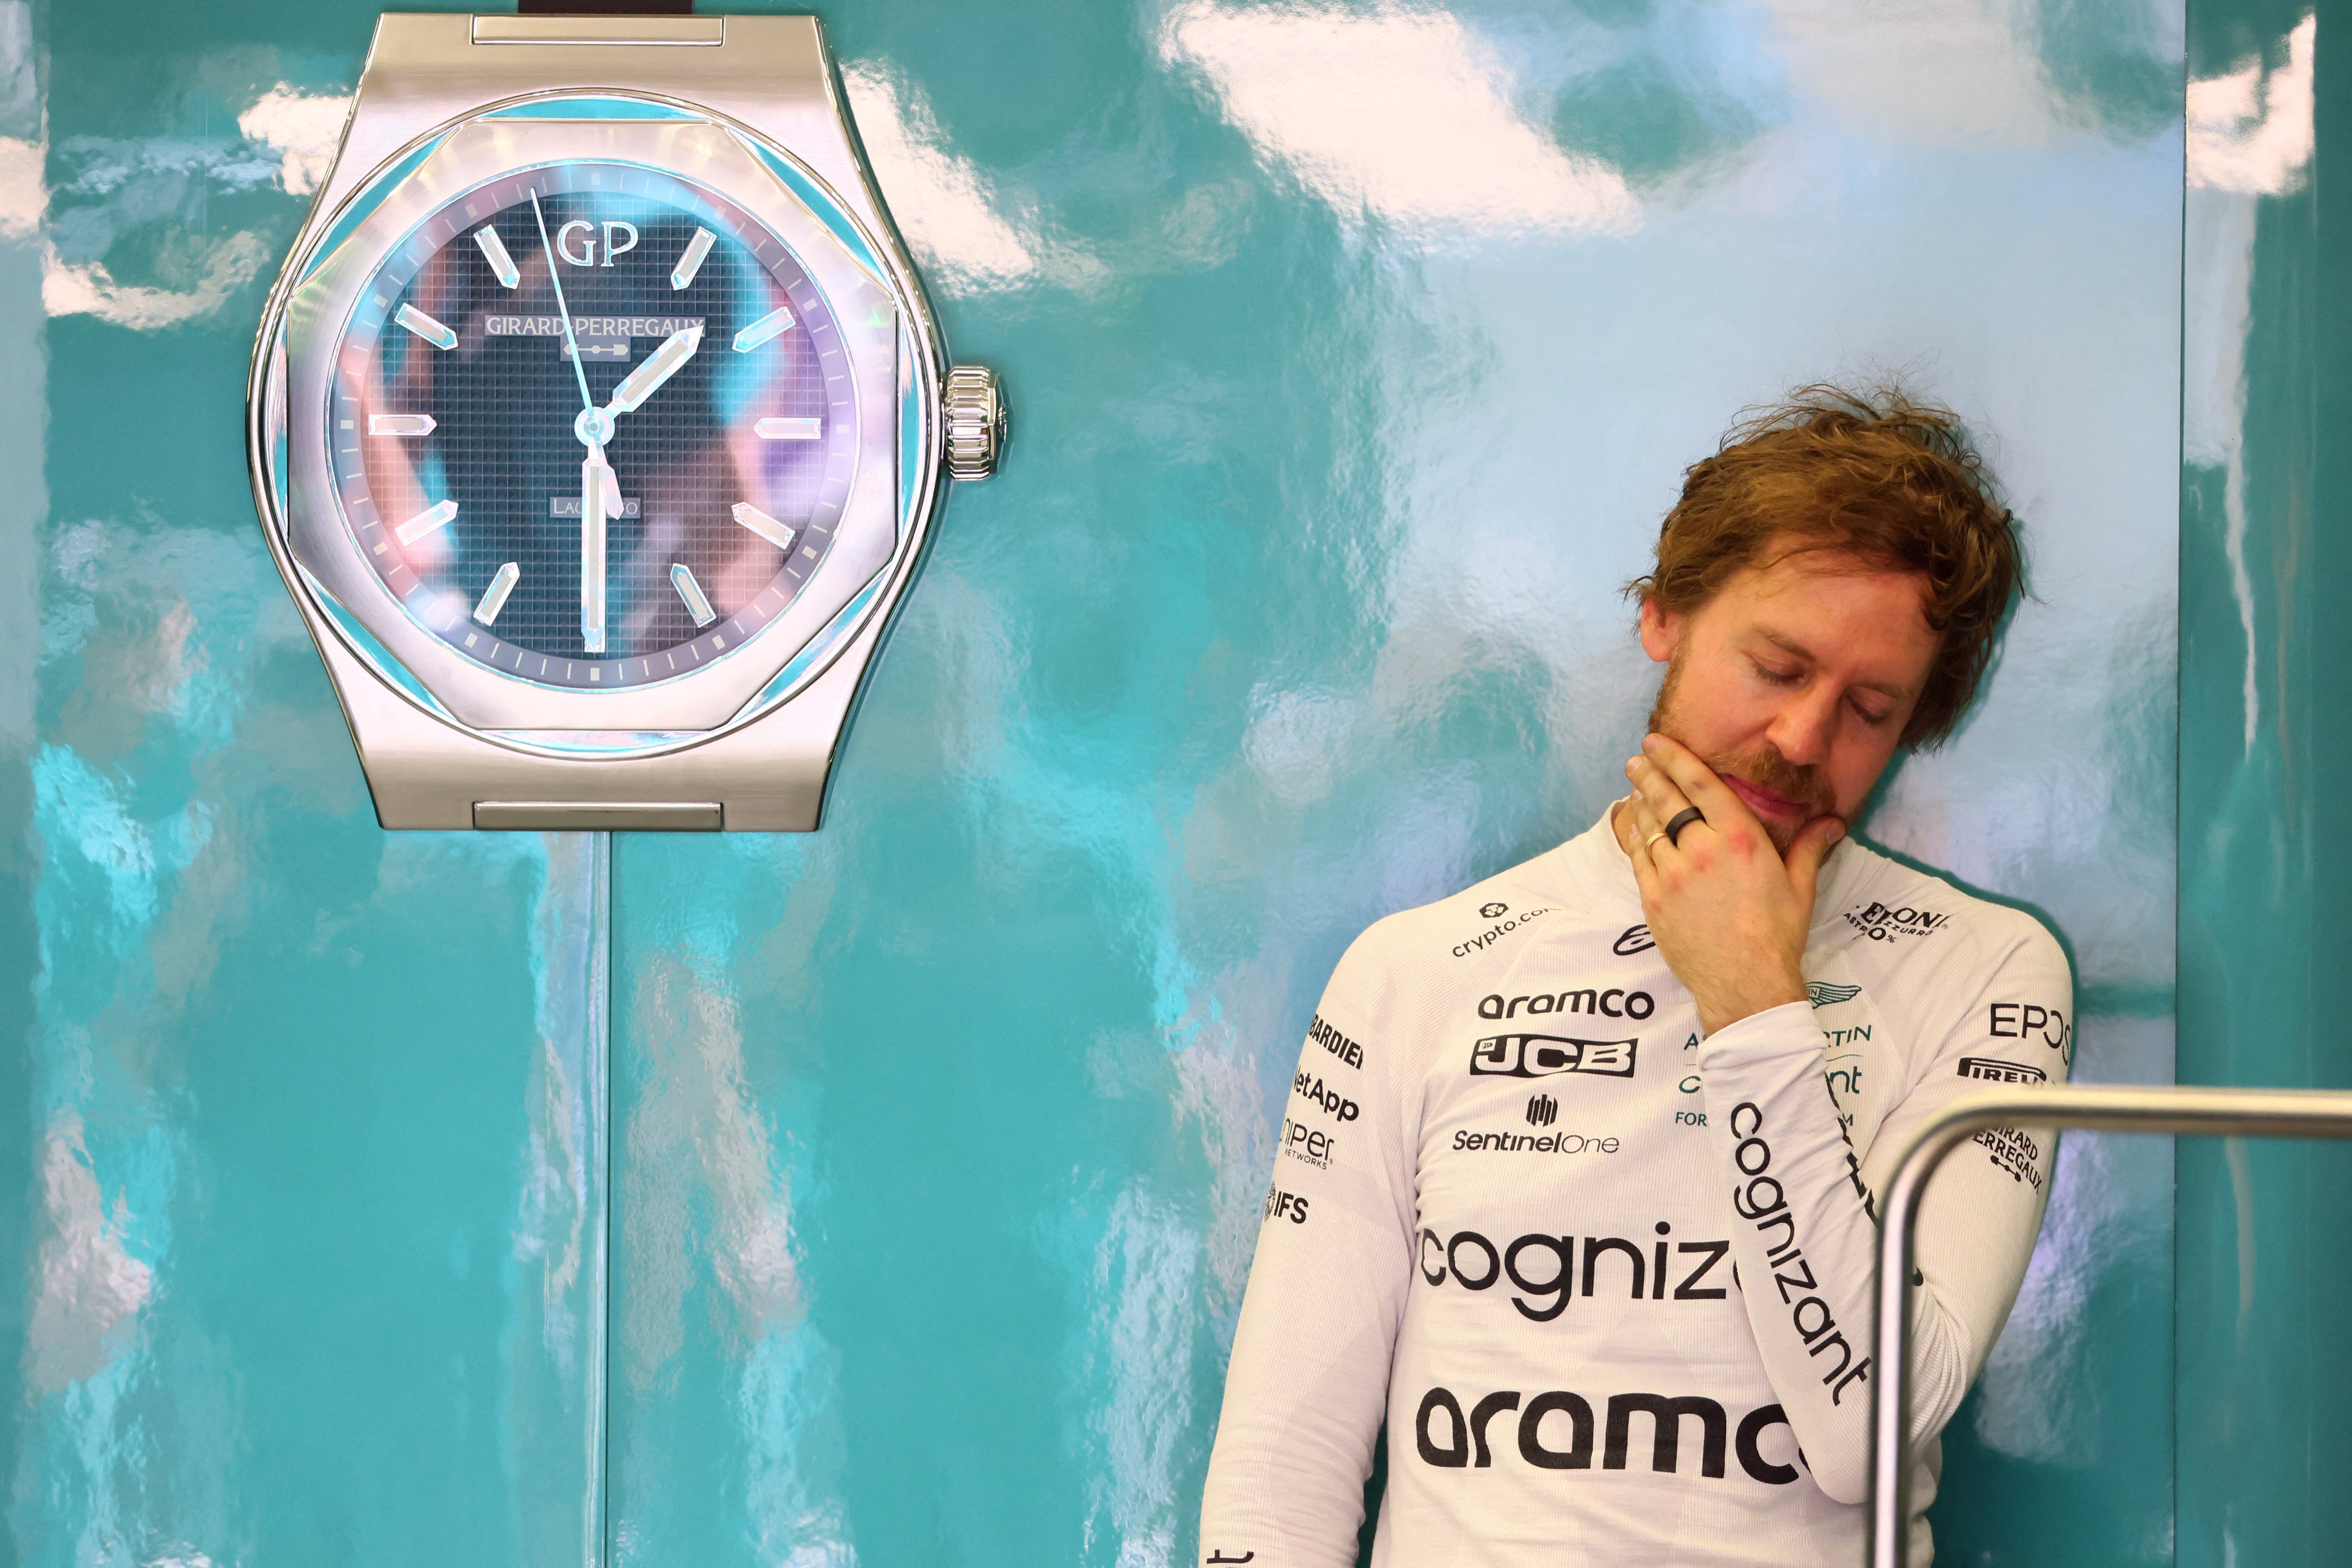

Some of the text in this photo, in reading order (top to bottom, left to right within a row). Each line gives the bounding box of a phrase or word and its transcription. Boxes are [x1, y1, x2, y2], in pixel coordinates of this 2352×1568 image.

[557, 220, 639, 267] GP
[1478, 989, 1654, 1019] aramco
[1475, 1037, 1631, 1075] JCB
[1285, 1148, 1327, 1170] NETWORKS
[1453, 1130, 1619, 1154] SentinelOne
[1273, 1191, 1309, 1224] IFS
[1421, 1221, 1743, 1321] cogniz
[1730, 1102, 1872, 1407] cognizant
[1416, 1387, 1810, 1484] aramc
